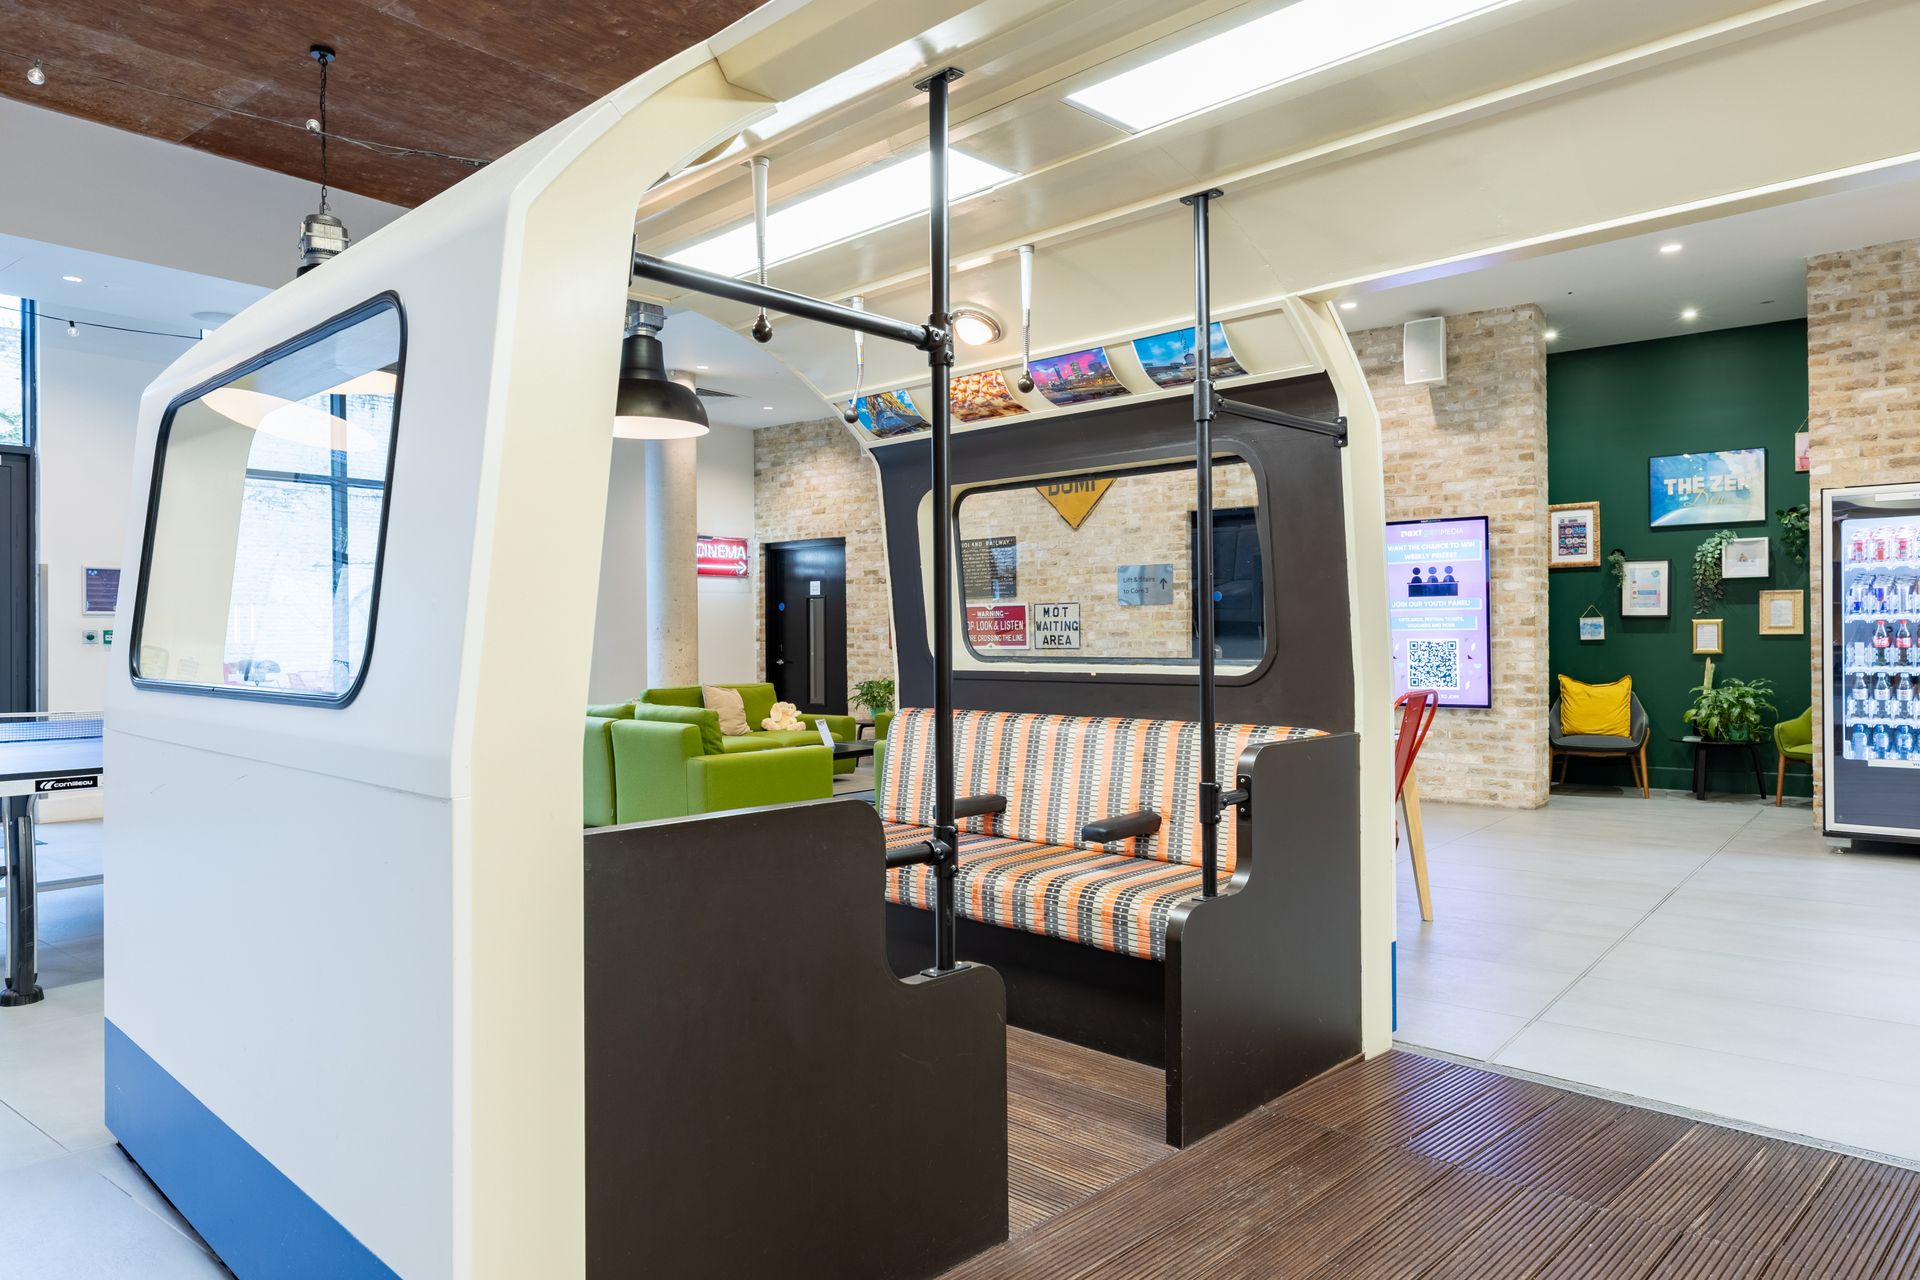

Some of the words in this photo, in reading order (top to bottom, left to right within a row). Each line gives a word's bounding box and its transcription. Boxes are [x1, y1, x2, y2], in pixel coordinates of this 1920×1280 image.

[1663, 477, 1705, 496] THE
[1401, 529, 1423, 538] next
[1440, 527, 1464, 536] MEDIA
[1387, 544, 1407, 552] WANT
[1408, 543, 1420, 551] THE
[976, 609, 1005, 617] WARNING
[976, 620, 993, 631] LOOK
[993, 620, 999, 630] &
[1000, 619, 1024, 631] LISTEN
[1036, 620, 1079, 632] WAITING
[978, 634, 1002, 642] CROSSING
[1002, 634, 1012, 642] THE
[1042, 635, 1072, 646] AREA
